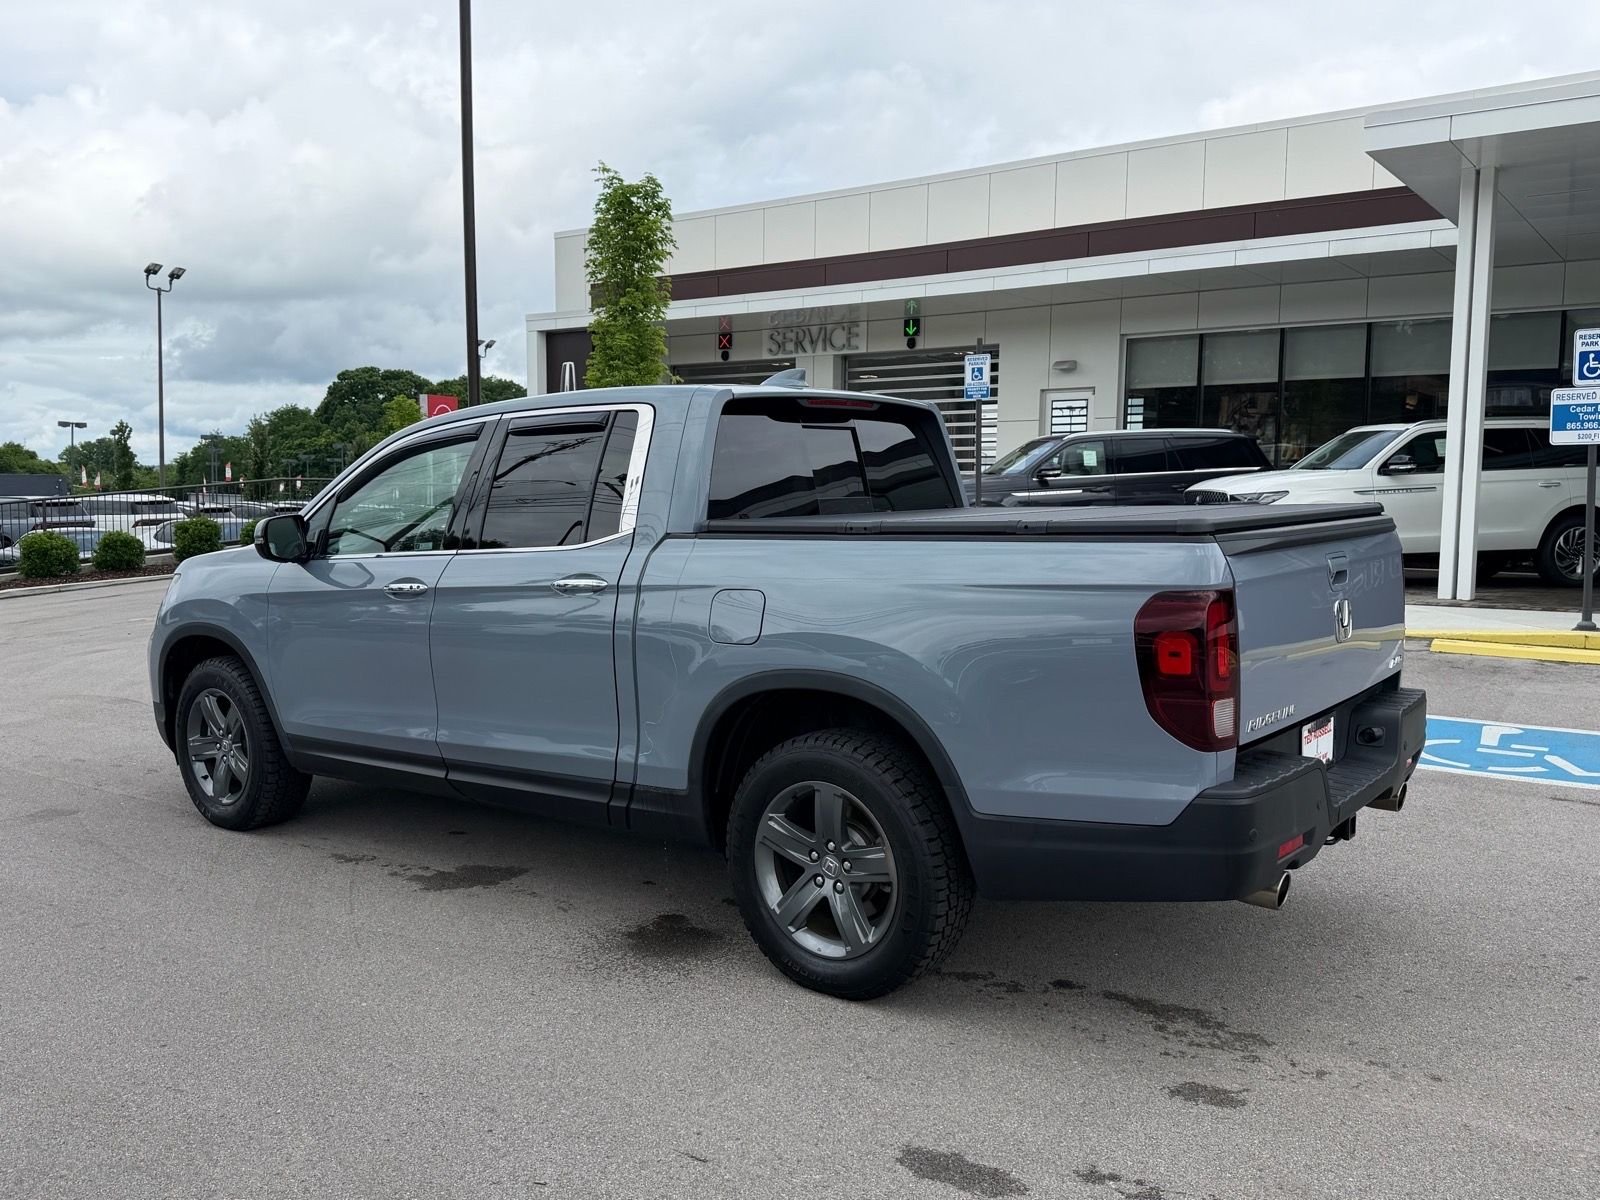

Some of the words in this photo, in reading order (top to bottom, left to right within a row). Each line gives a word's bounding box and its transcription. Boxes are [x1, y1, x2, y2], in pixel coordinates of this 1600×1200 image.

[768, 323, 860, 356] SERVICE
[1556, 391, 1597, 401] RESERVED
[1570, 405, 1595, 413] Cedar
